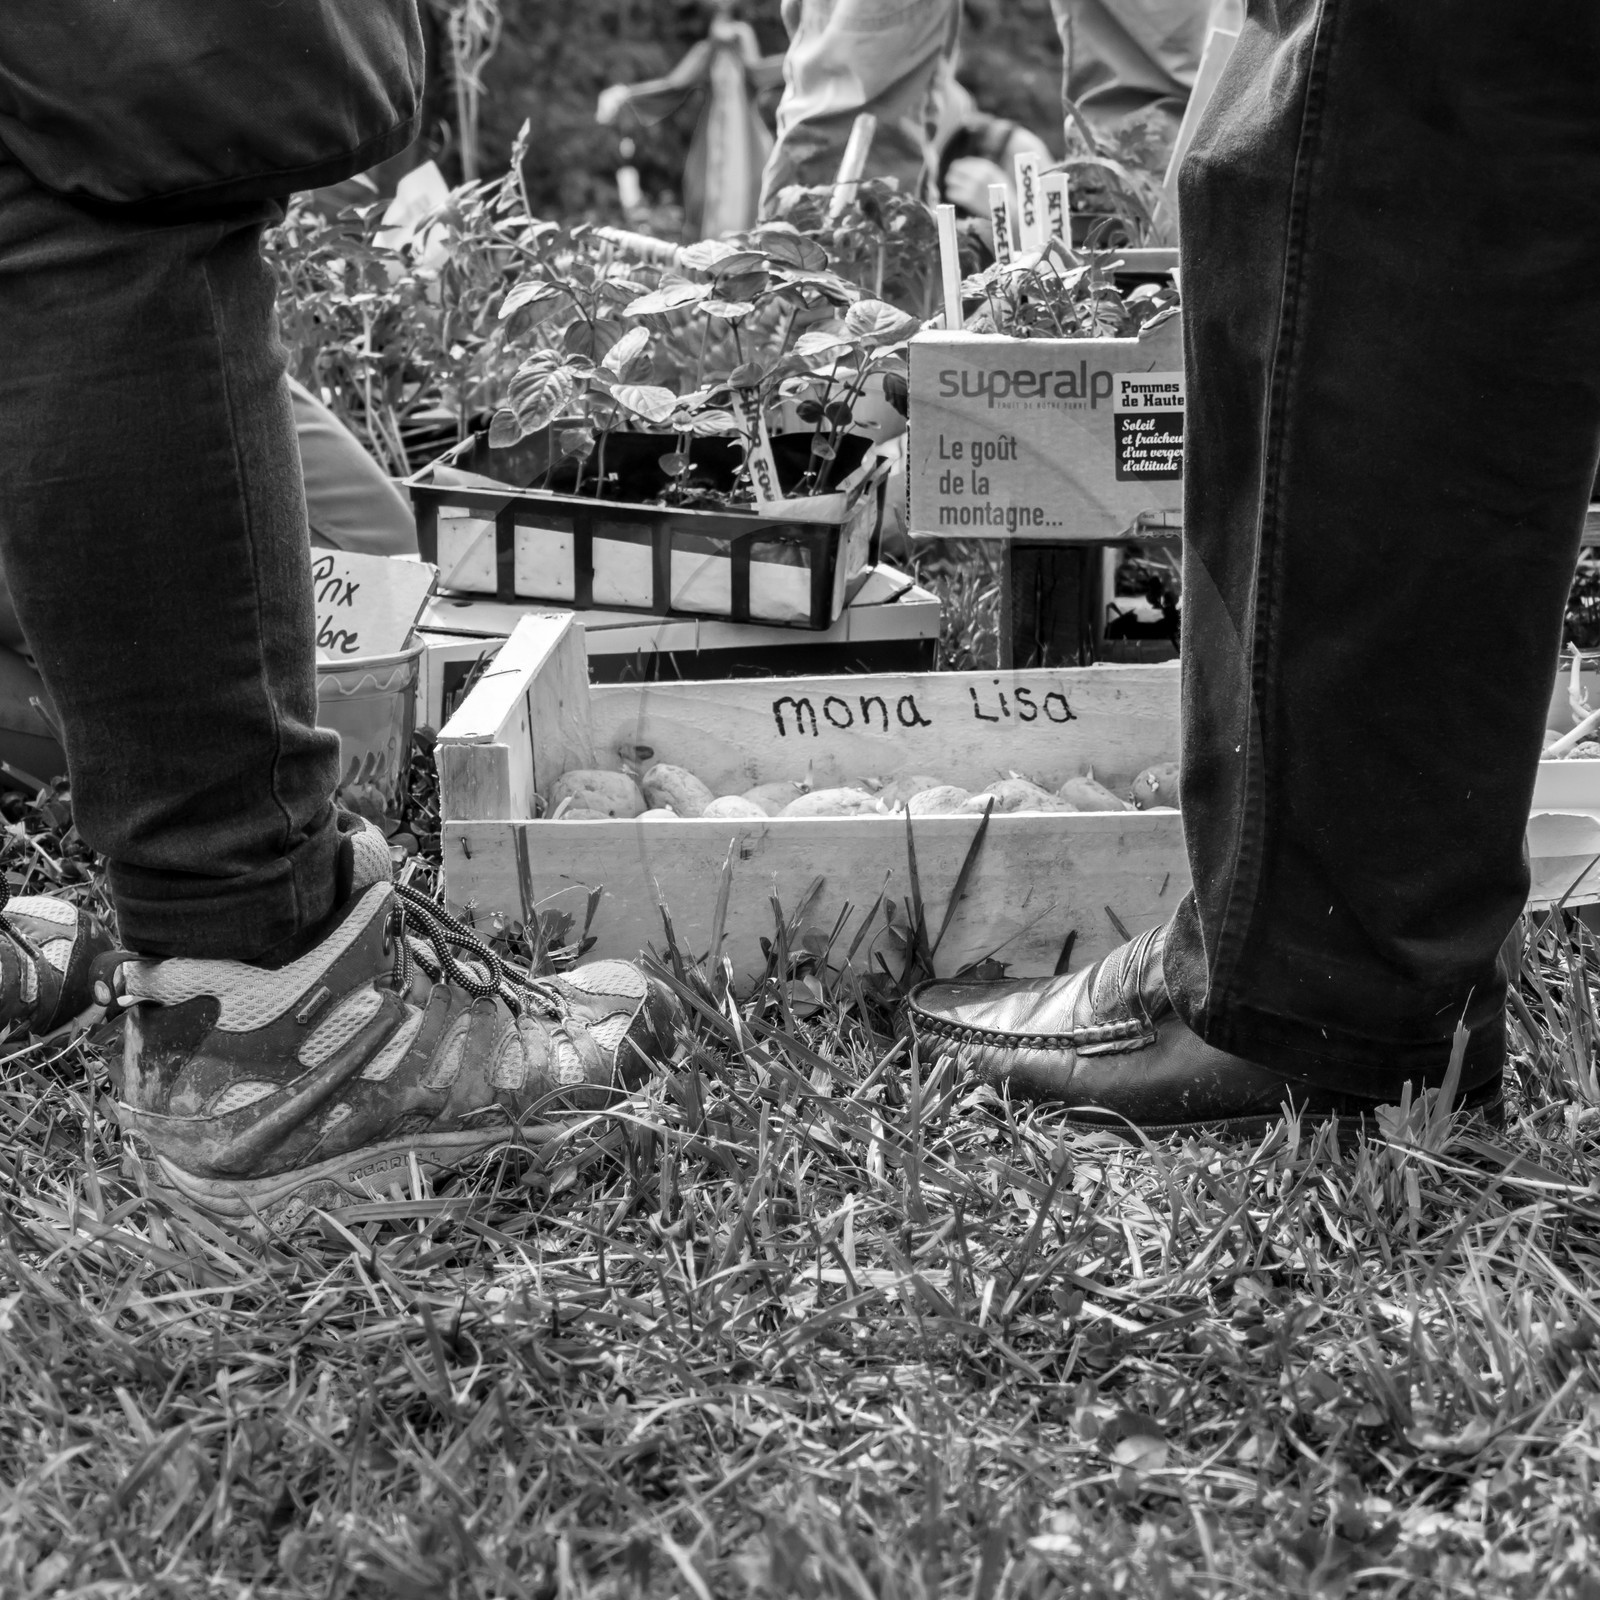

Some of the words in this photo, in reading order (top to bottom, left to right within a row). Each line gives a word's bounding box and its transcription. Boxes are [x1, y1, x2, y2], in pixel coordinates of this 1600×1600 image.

[1021, 165, 1035, 227] SOUCIS
[1046, 191, 1064, 240] BETT
[993, 201, 1011, 264] TAGET
[1121, 381, 1180, 394] Pommes
[1122, 394, 1139, 407] de
[1122, 418, 1156, 431] Soleil
[939, 434, 964, 460] Le
[971, 435, 1017, 467] goût
[1122, 434, 1133, 445] et
[1135, 432, 1184, 448] fraîcheu
[1122, 446, 1148, 458] d'un
[1122, 459, 1178, 472] d'altitude
[939, 470, 964, 495] de
[971, 470, 990, 495] la
[939, 502, 1063, 533] montagne...
[772, 695, 932, 737] mona
[969, 679, 1078, 723] Lisa
